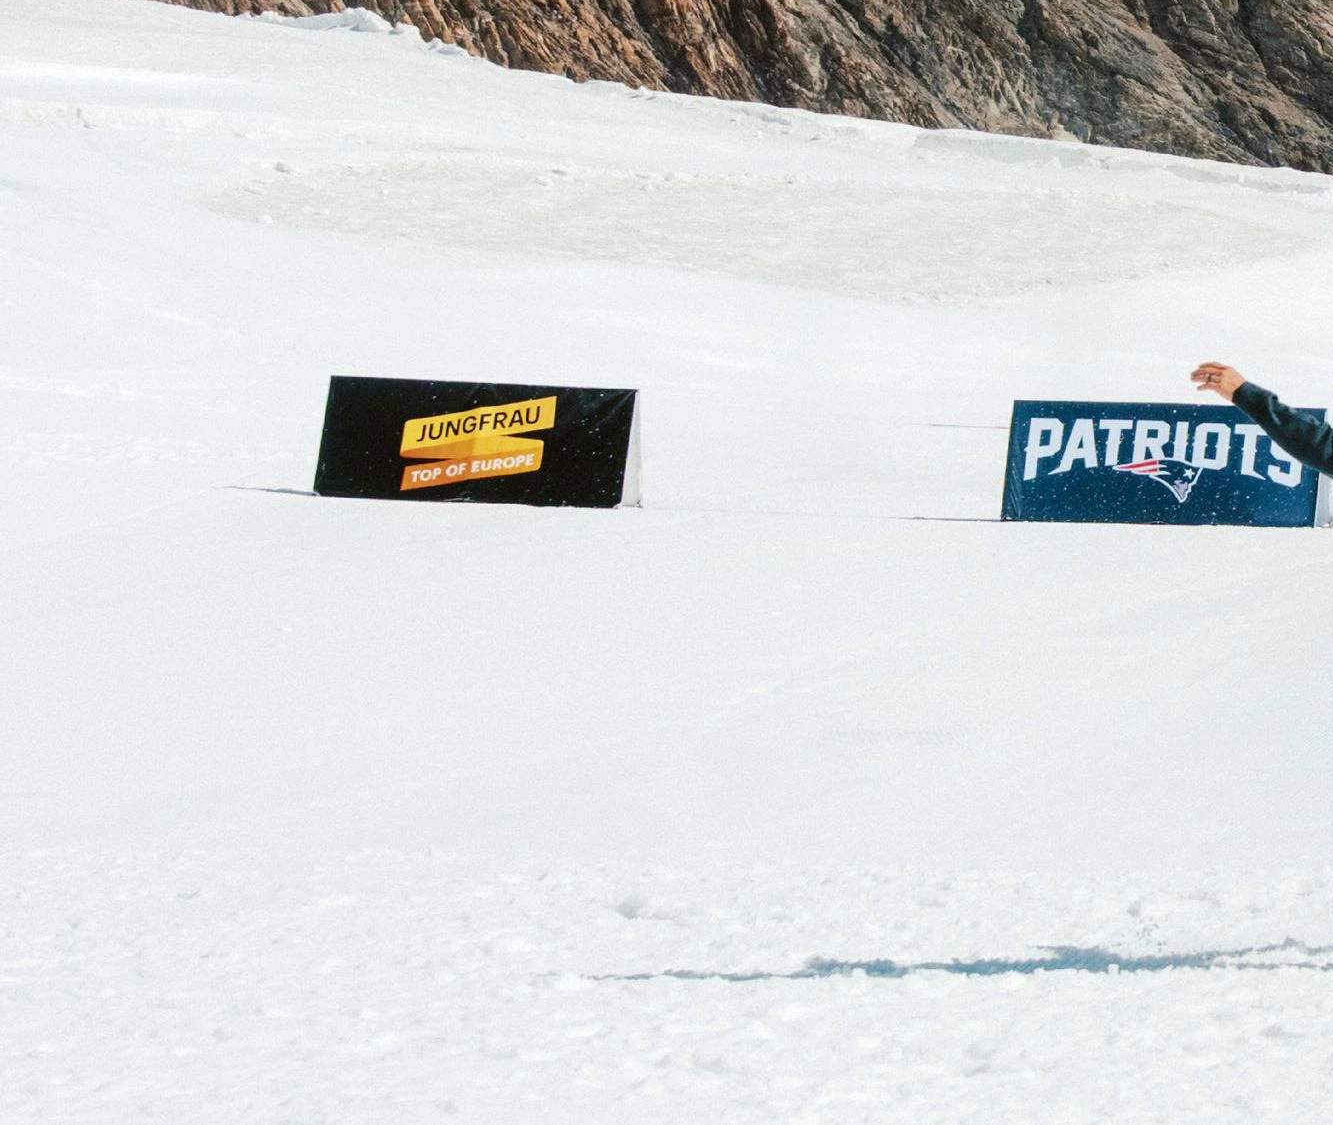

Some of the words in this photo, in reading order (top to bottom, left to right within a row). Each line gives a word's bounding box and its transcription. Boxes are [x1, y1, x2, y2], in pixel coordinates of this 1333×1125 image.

[416, 406, 541, 442] JUNGFRAU
[411, 469, 441, 483] TOP
[445, 463, 467, 477] OF
[471, 453, 536, 474] EUROPE
[1023, 417, 1303, 488] PATRIOTS
